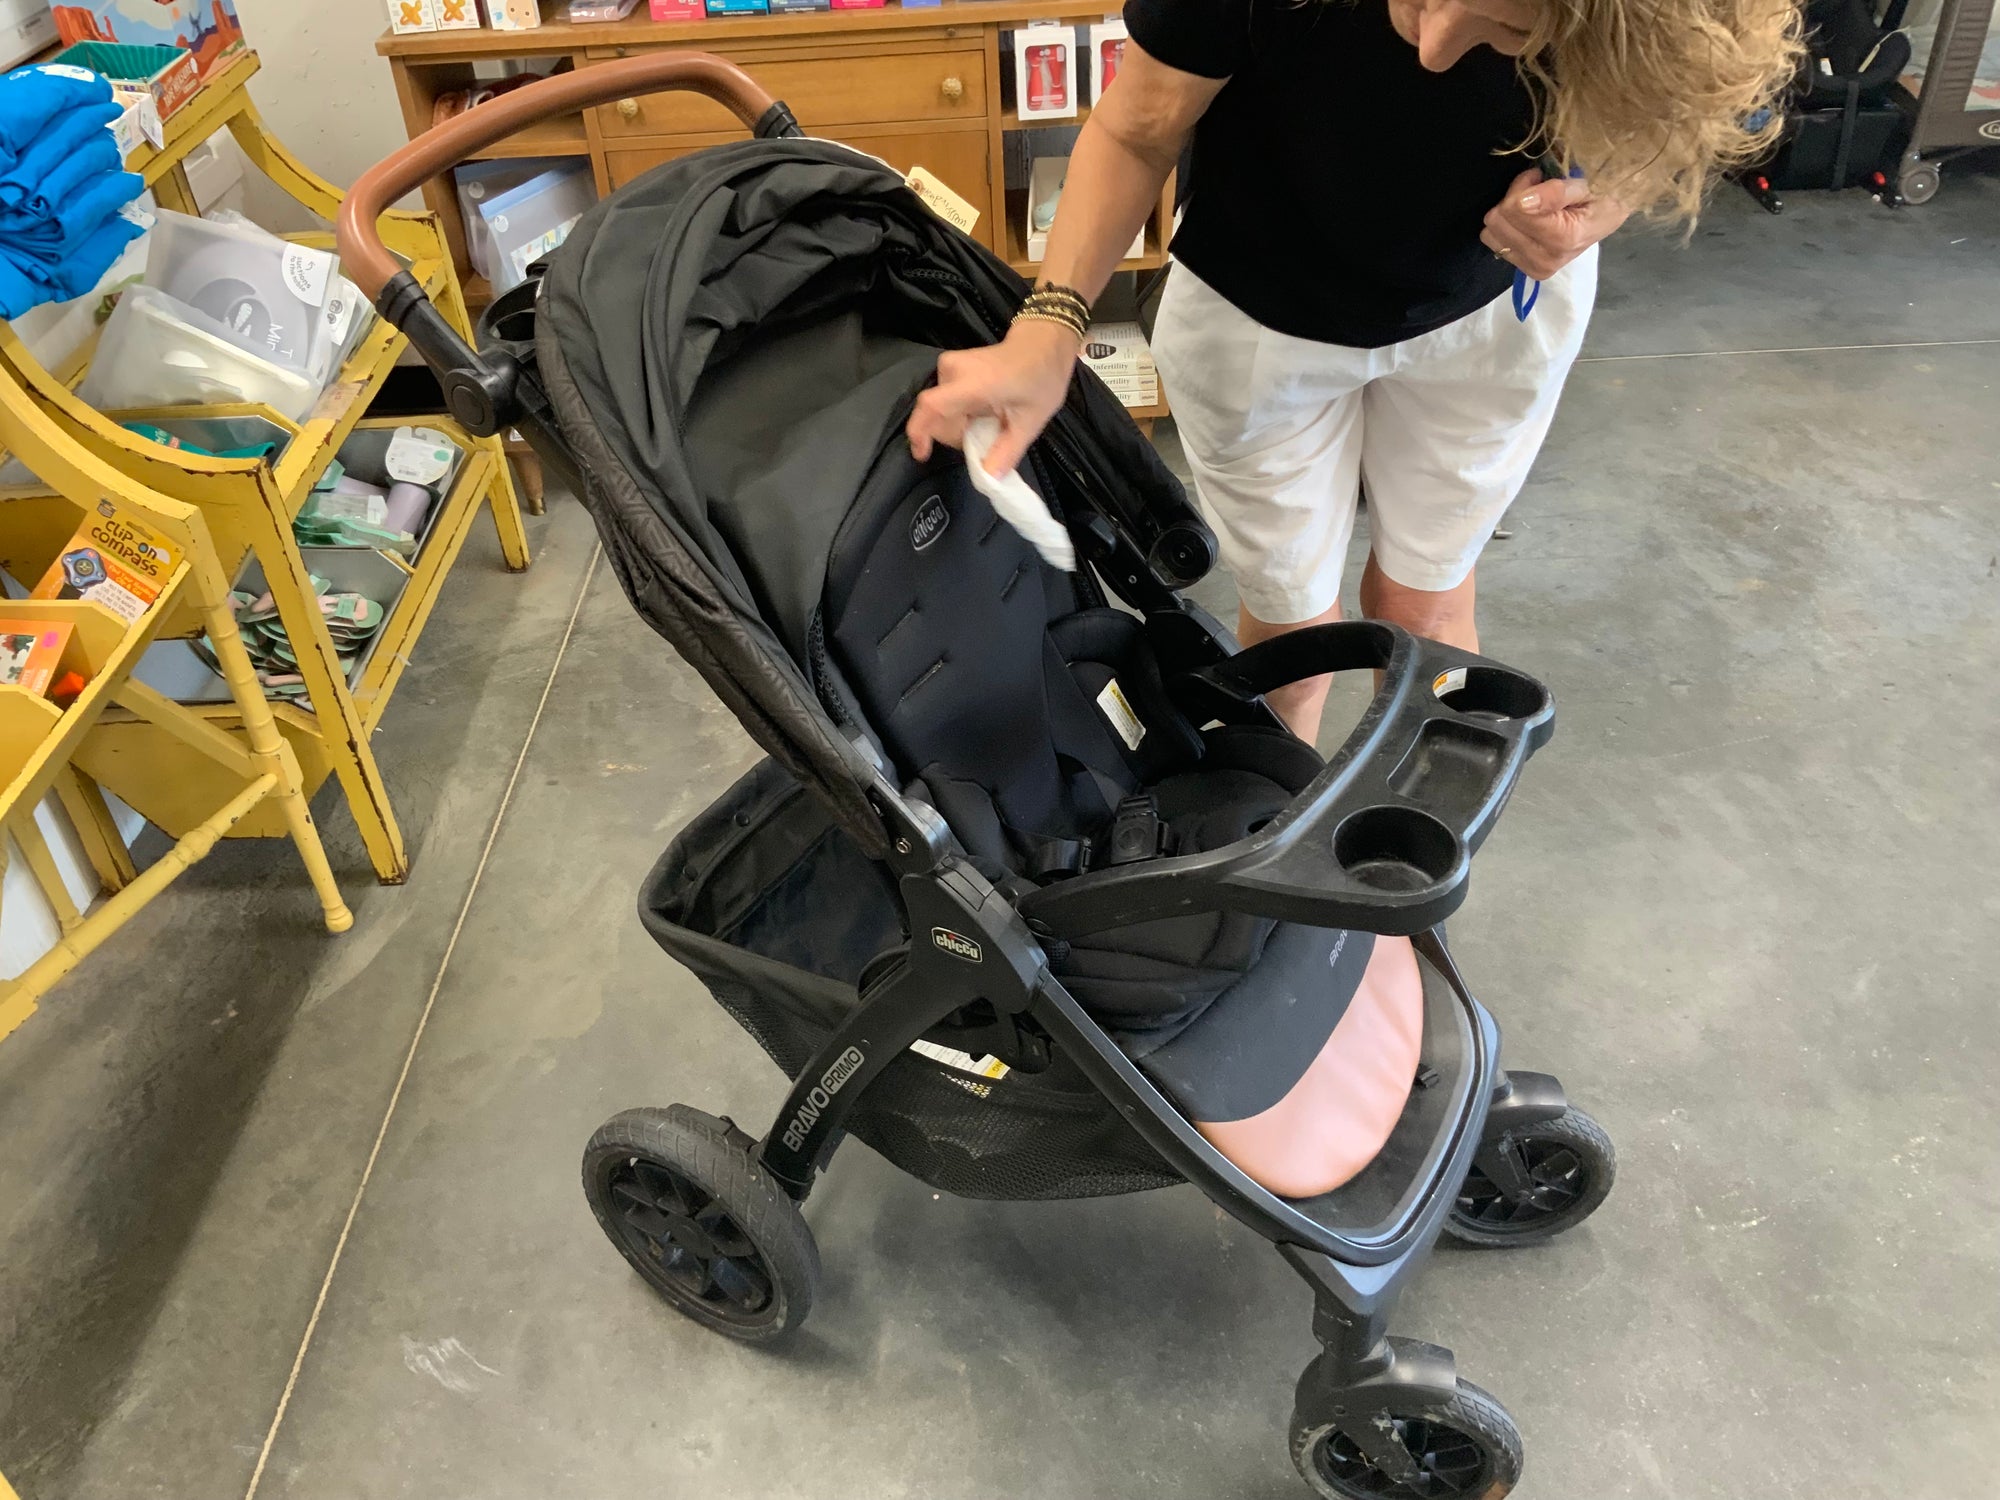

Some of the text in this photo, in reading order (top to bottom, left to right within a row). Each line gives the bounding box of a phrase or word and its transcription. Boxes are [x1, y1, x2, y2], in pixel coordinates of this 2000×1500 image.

[1093, 363, 1128, 371] Infertility
[912, 506, 944, 544] chicco
[936, 934, 979, 959] chicco
[782, 1049, 861, 1153] BRAVO PRIMO
